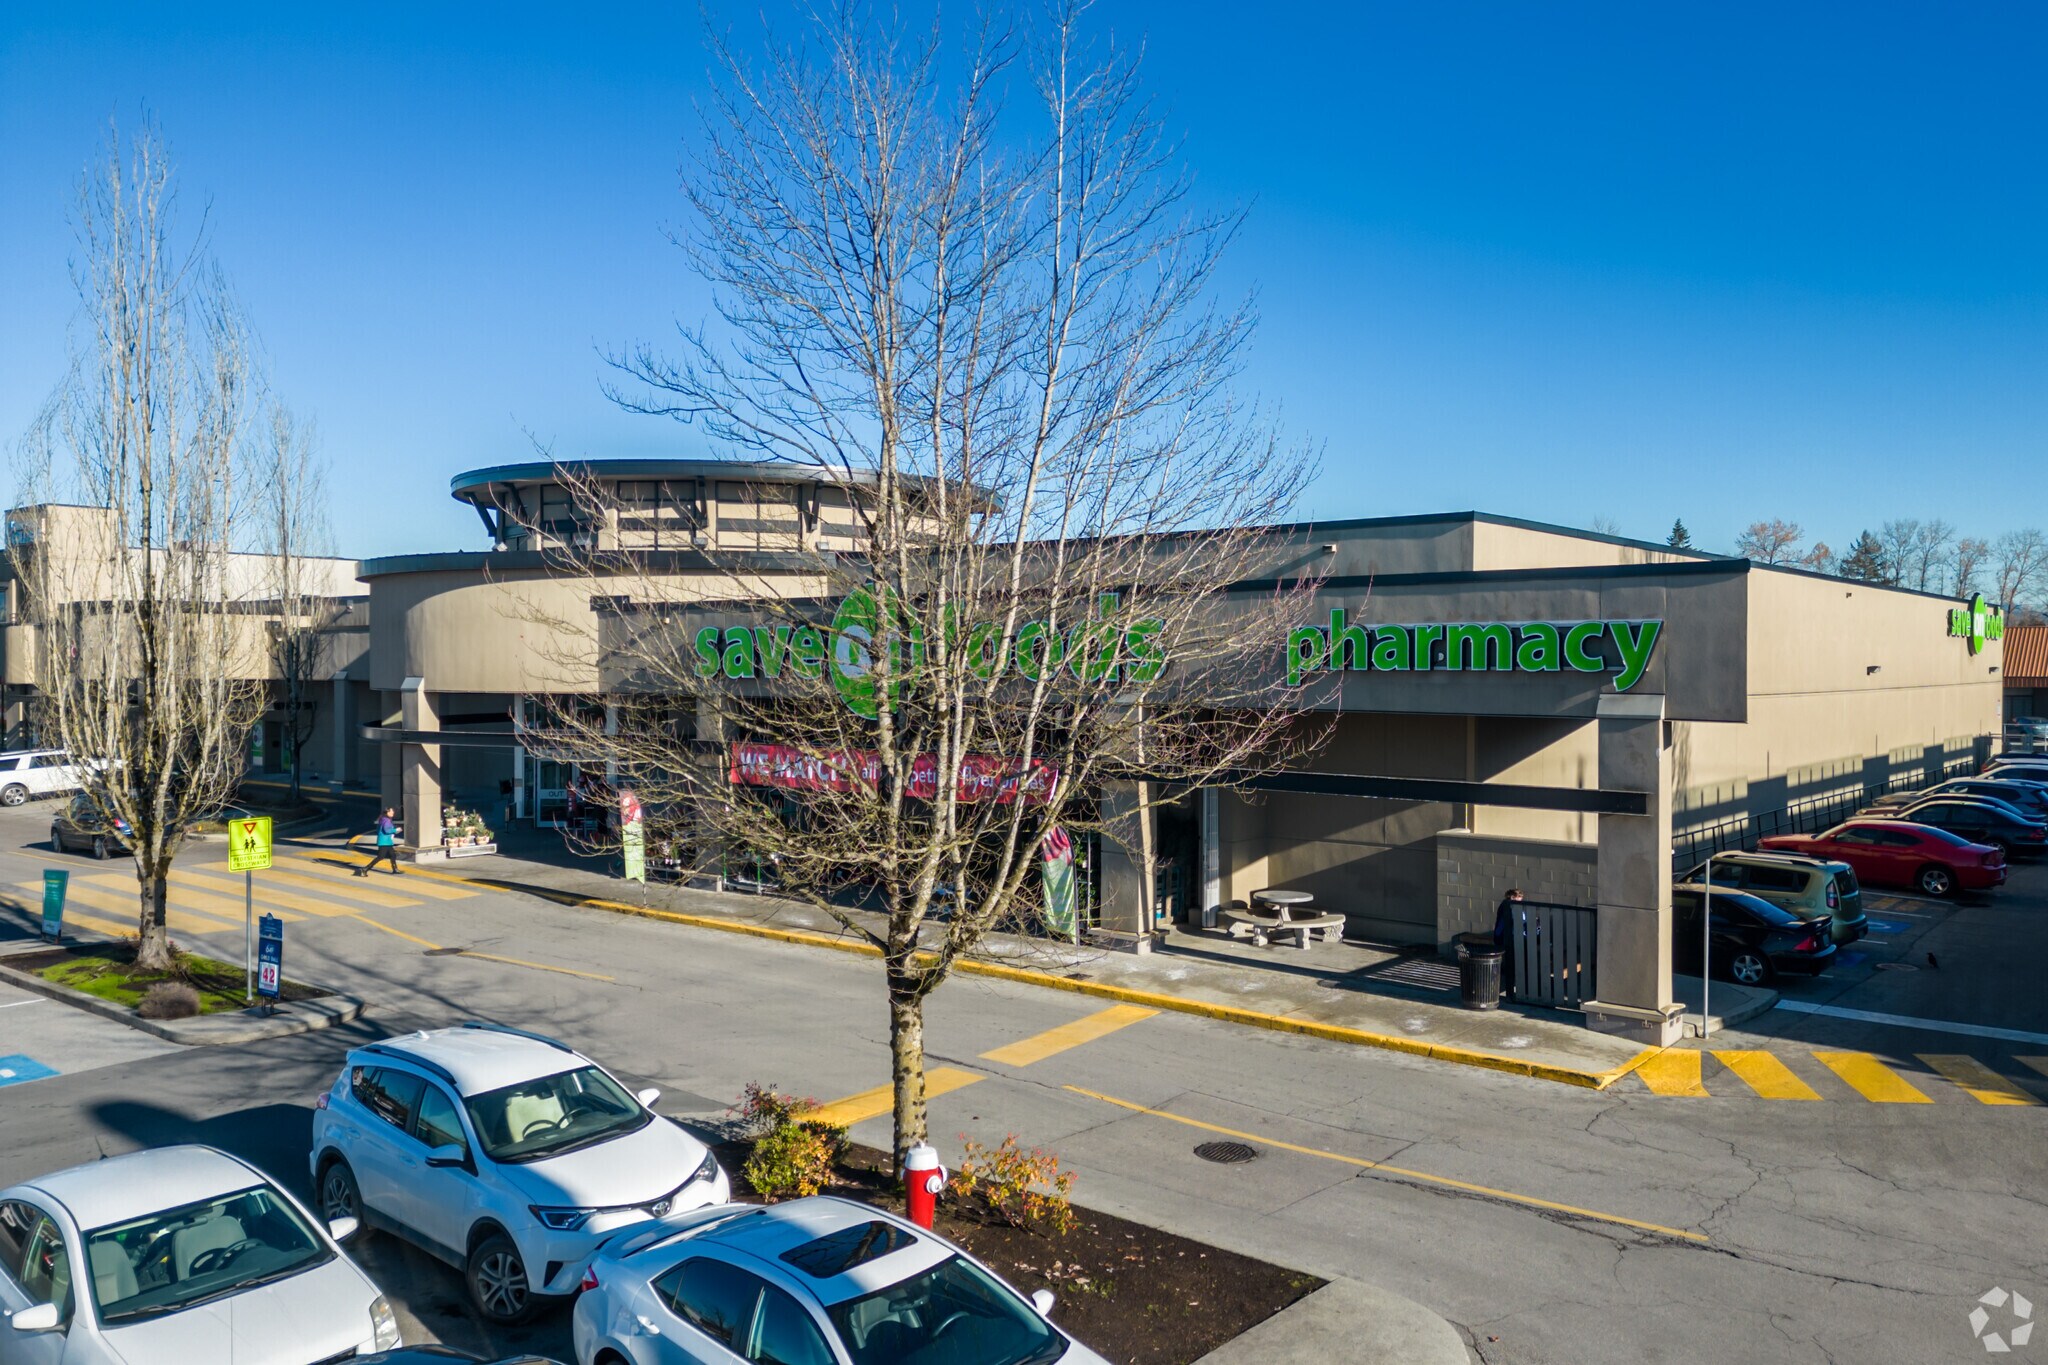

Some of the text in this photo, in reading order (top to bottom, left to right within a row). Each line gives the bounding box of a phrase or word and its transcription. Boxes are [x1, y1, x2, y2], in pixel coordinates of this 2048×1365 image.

[1951, 608, 1971, 638] save
[694, 625, 825, 680] save
[1286, 608, 1663, 692] pharmacy
[740, 752, 769, 775] WE
[774, 753, 848, 781] MATCH
[861, 760, 877, 780] all
[548, 790, 565, 798] OUT
[232, 854, 268, 863] PEDESTRIAN
[232, 860, 268, 869] CROSSWALK
[263, 967, 275, 984] 42
